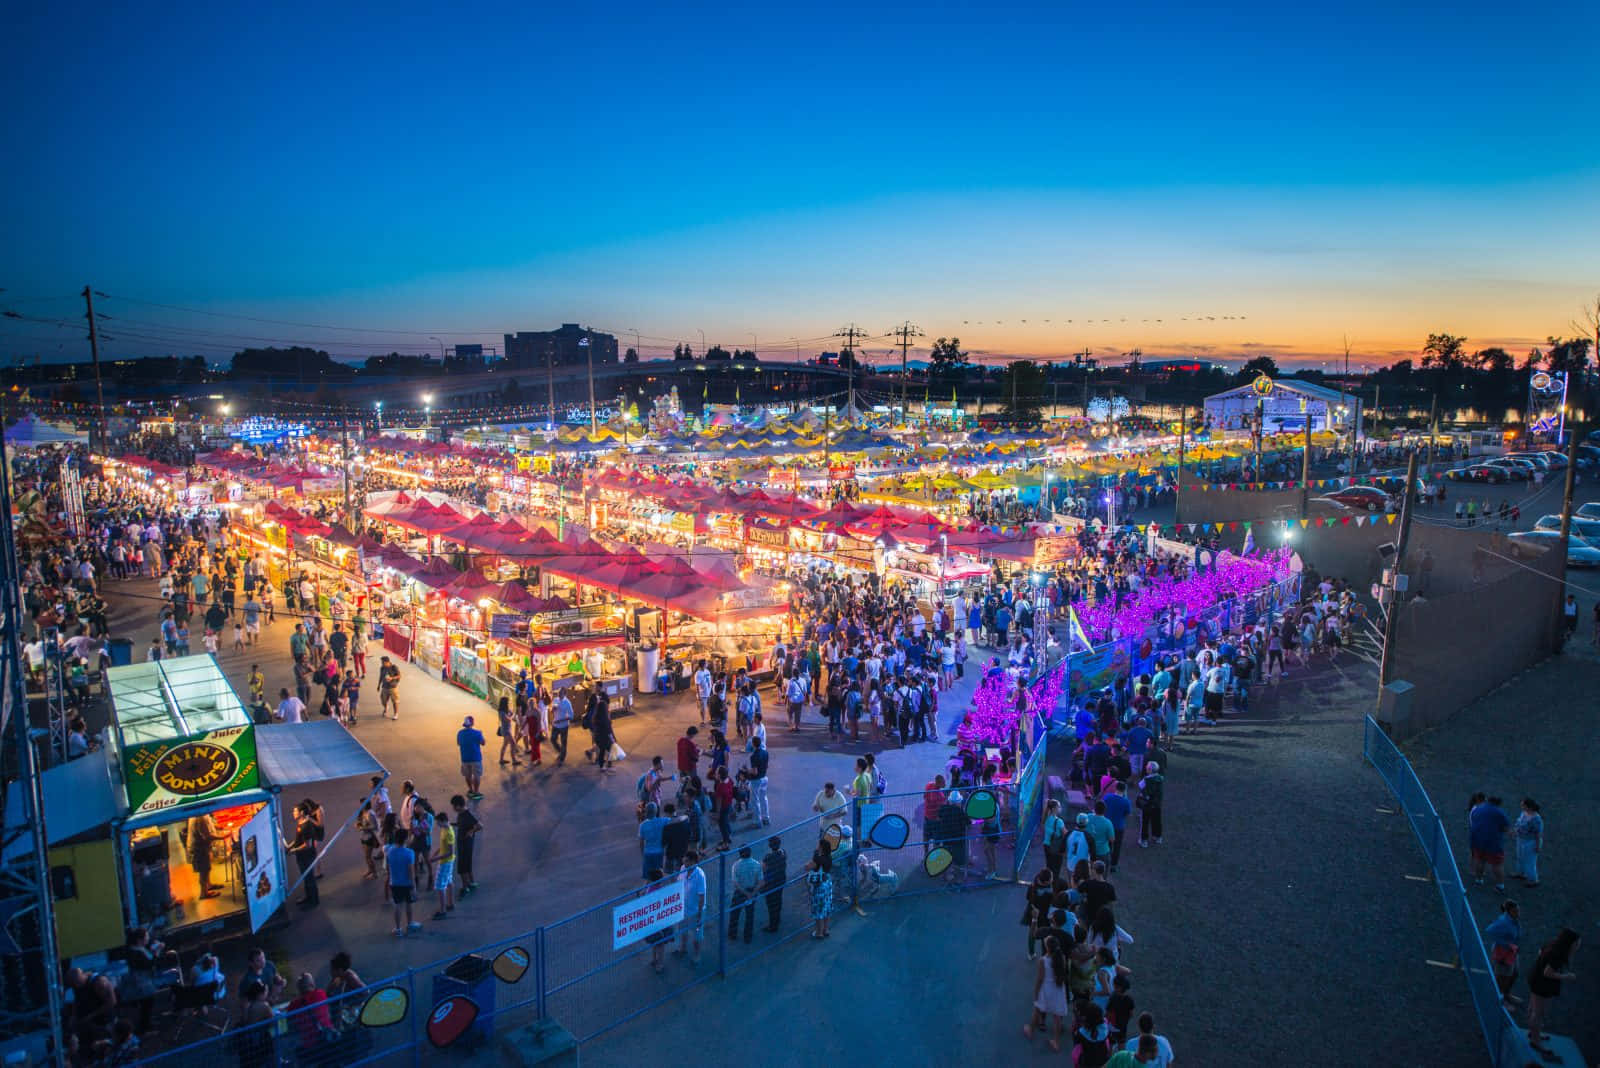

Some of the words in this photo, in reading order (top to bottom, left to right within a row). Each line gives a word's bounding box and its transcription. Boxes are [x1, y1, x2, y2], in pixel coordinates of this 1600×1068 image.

[211, 728, 242, 740] Juice
[164, 746, 221, 769] MINI
[160, 761, 226, 789] DONUTS
[142, 798, 176, 810] Coffee
[616, 927, 628, 938] NO
[629, 915, 655, 933] PUBLIC
[657, 903, 683, 921] ACCESS
[619, 901, 661, 925] RESTRICTED
[663, 892, 681, 906] AREA
